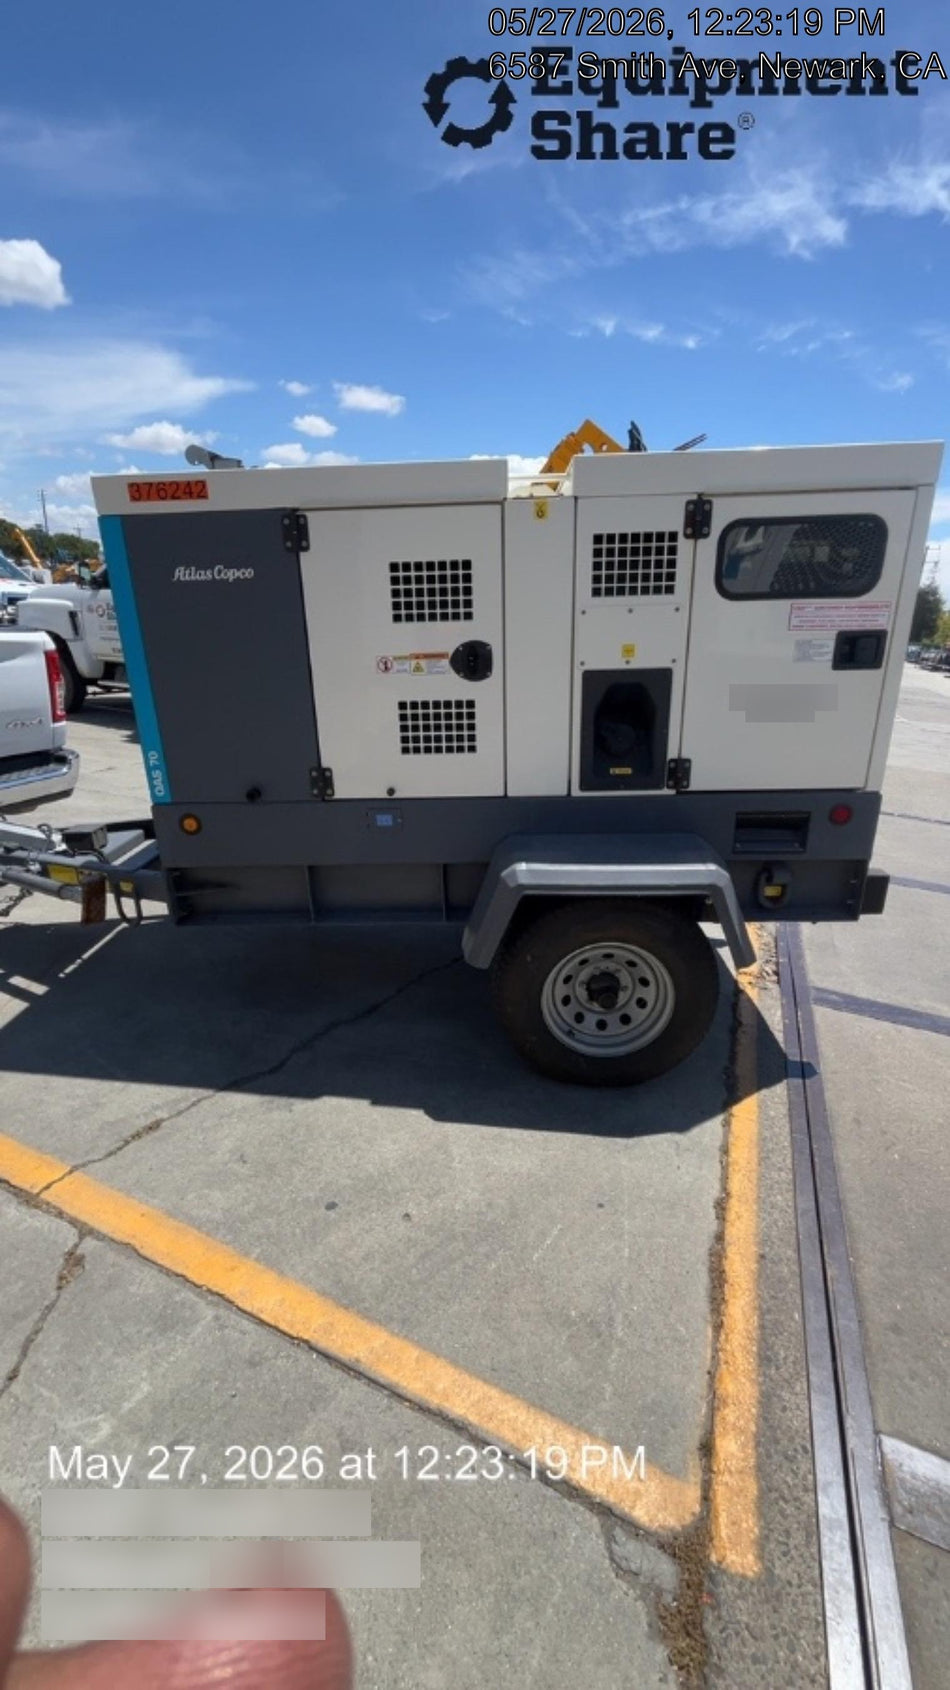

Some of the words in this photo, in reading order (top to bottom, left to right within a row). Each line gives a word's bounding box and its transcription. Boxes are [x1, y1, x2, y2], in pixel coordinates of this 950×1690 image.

[128, 480, 209, 502] 376242
[173, 566, 213, 582] Atlas
[213, 564, 255, 583] Copco
[148, 750, 161, 766] 70
[151, 769, 165, 797] QAS
